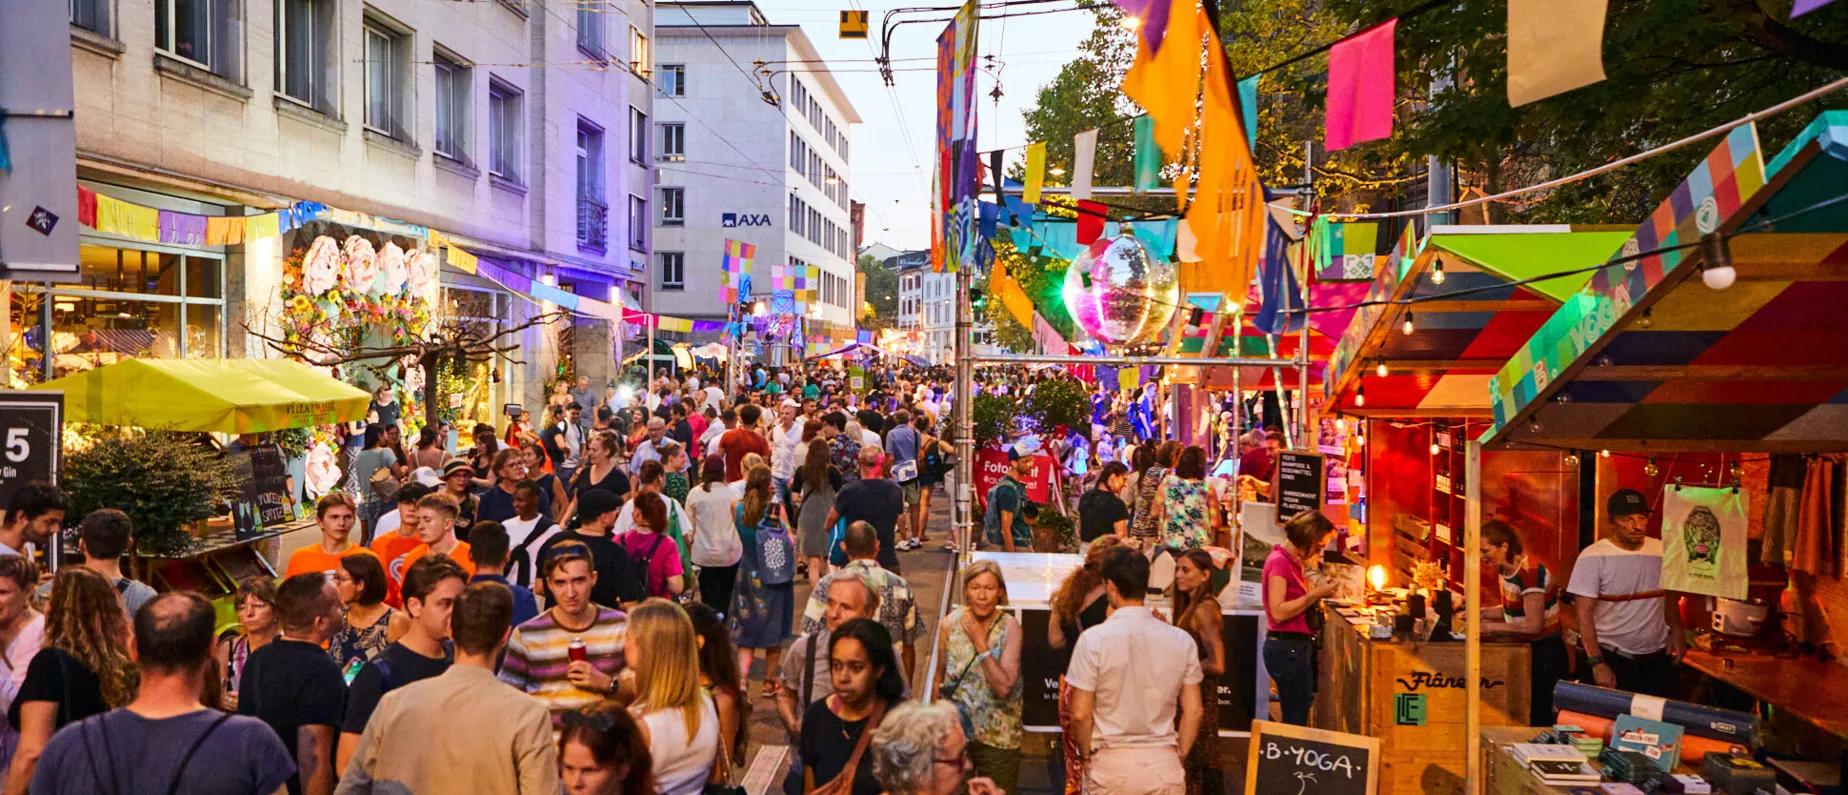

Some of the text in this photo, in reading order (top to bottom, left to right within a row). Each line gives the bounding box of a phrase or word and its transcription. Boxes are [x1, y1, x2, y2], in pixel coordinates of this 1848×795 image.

[738, 214, 771, 226] AXA
[5, 428, 30, 462] 5
[3, 466, 17, 478] Gin
[1396, 670, 1504, 691] Flâner
